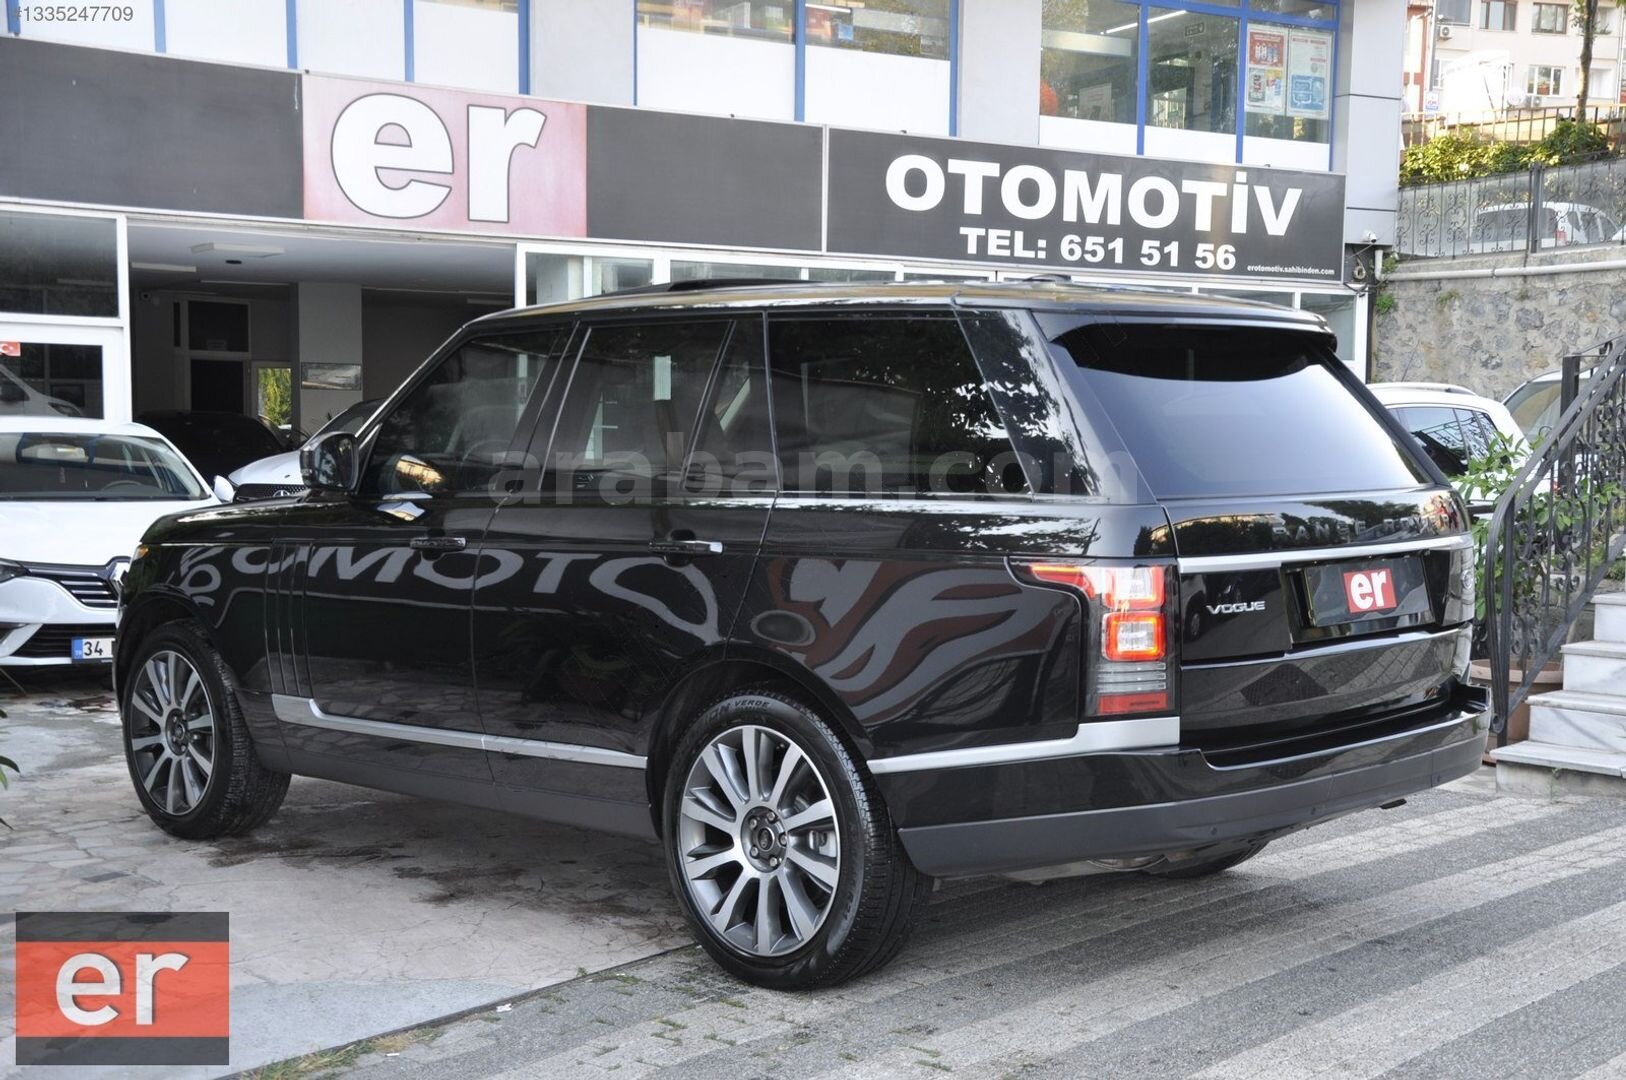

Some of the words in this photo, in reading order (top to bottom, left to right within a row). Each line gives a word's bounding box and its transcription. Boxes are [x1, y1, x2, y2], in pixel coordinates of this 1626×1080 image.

[331, 92, 547, 224] er
[885, 153, 1303, 237] OTOMOTİV
[959, 226, 1047, 259] TEL:
[1059, 234, 1124, 264] 651
[1139, 240, 1179, 267] 51
[1194, 243, 1236, 270] 56
[1205, 601, 1266, 615] VOGUE
[1350, 571, 1387, 609] er
[84, 640, 103, 656] 34
[735, 699, 770, 707] VERDE
